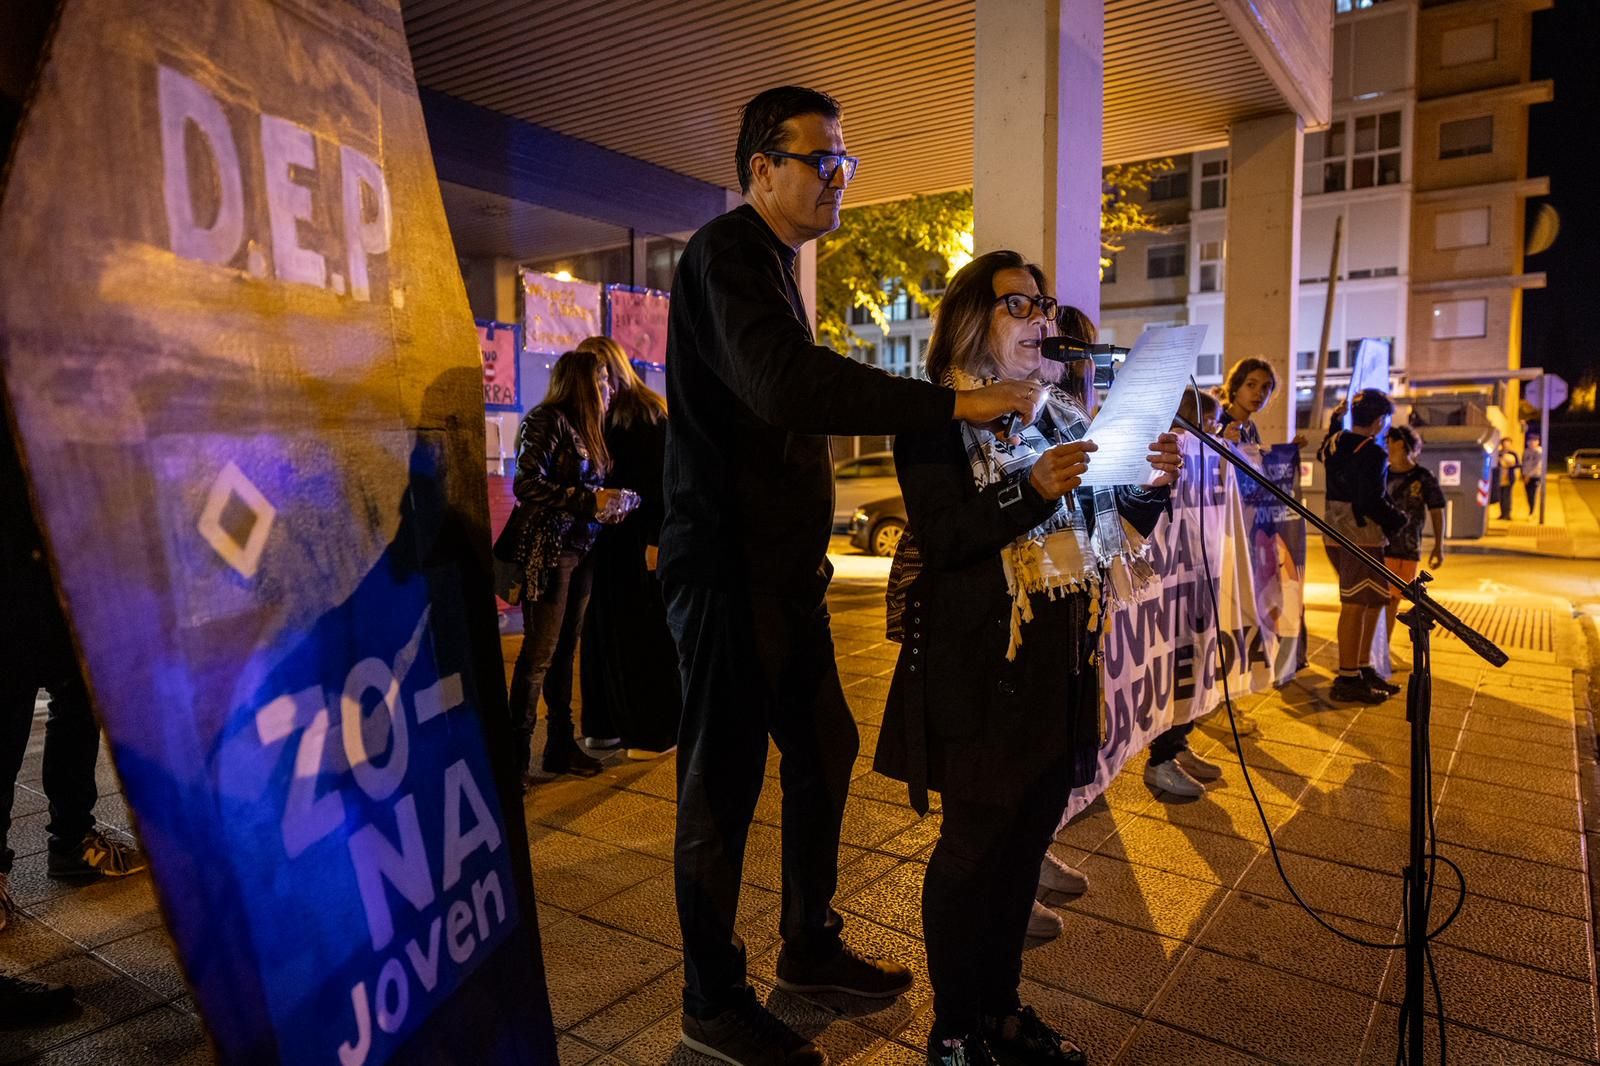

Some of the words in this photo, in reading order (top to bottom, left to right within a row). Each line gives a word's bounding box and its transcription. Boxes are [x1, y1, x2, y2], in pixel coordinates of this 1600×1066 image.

[484, 383, 513, 403] RRA
[348, 760, 501, 952] NA
[338, 868, 506, 1066] Joven
